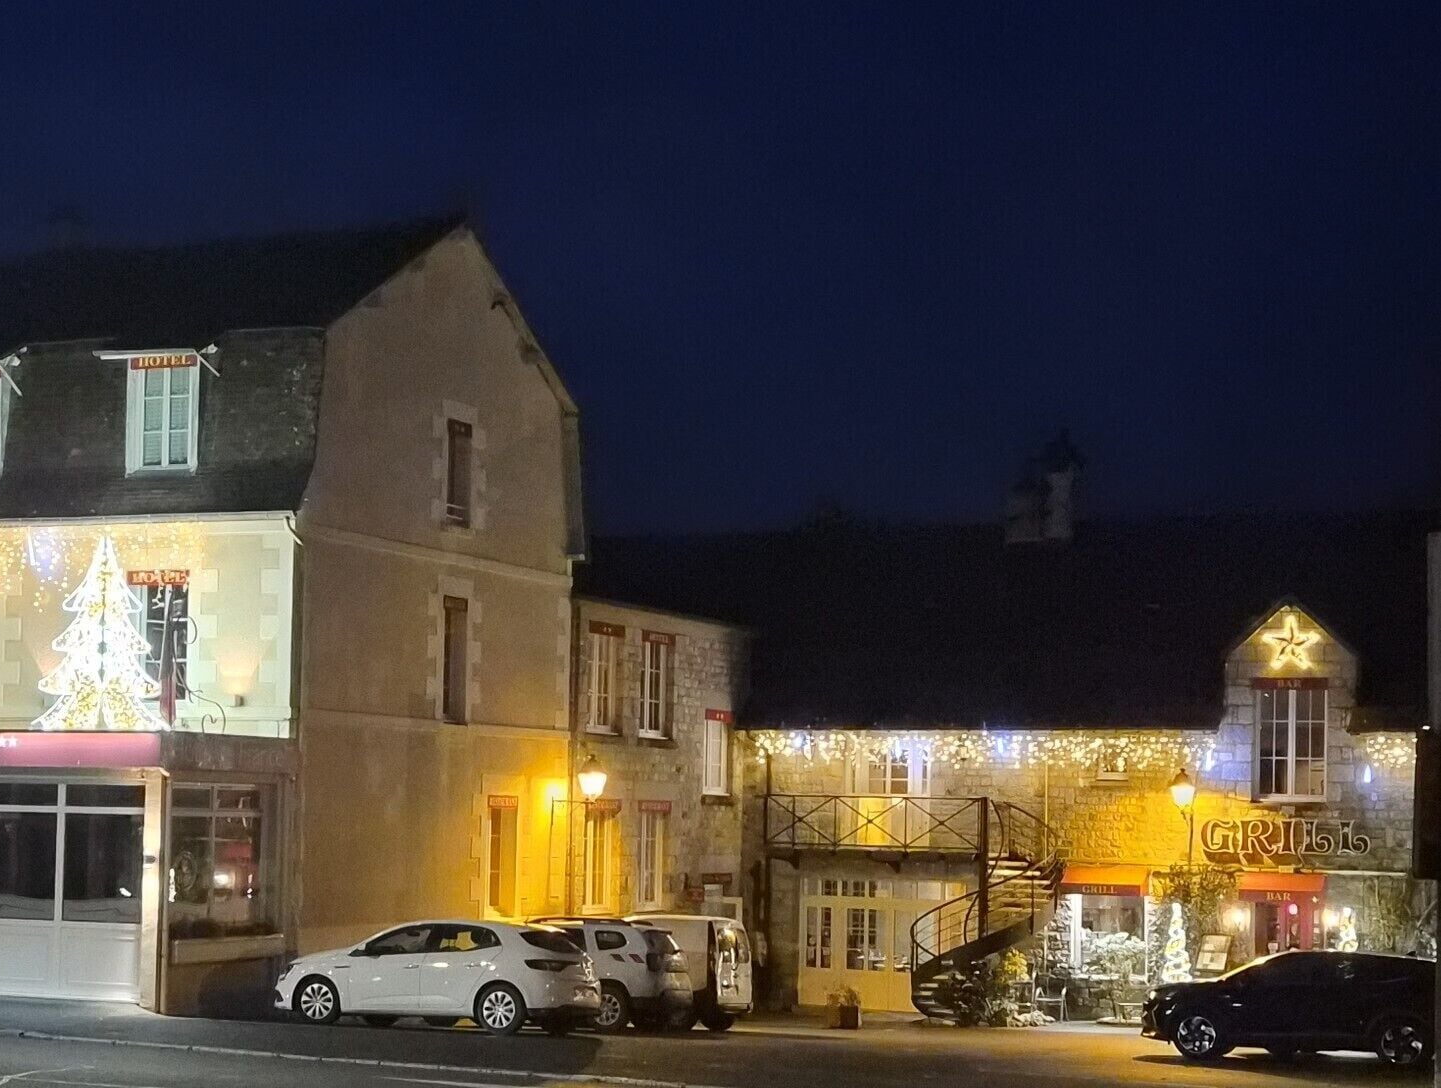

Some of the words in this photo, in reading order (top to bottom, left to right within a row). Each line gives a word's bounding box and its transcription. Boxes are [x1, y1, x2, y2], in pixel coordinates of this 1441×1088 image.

[139, 355, 191, 367] HOTEL
[1277, 679, 1301, 689] BAR
[1201, 818, 1370, 857] GRILL
[1082, 885, 1117, 894] GRILL
[1266, 892, 1292, 901] BAR
